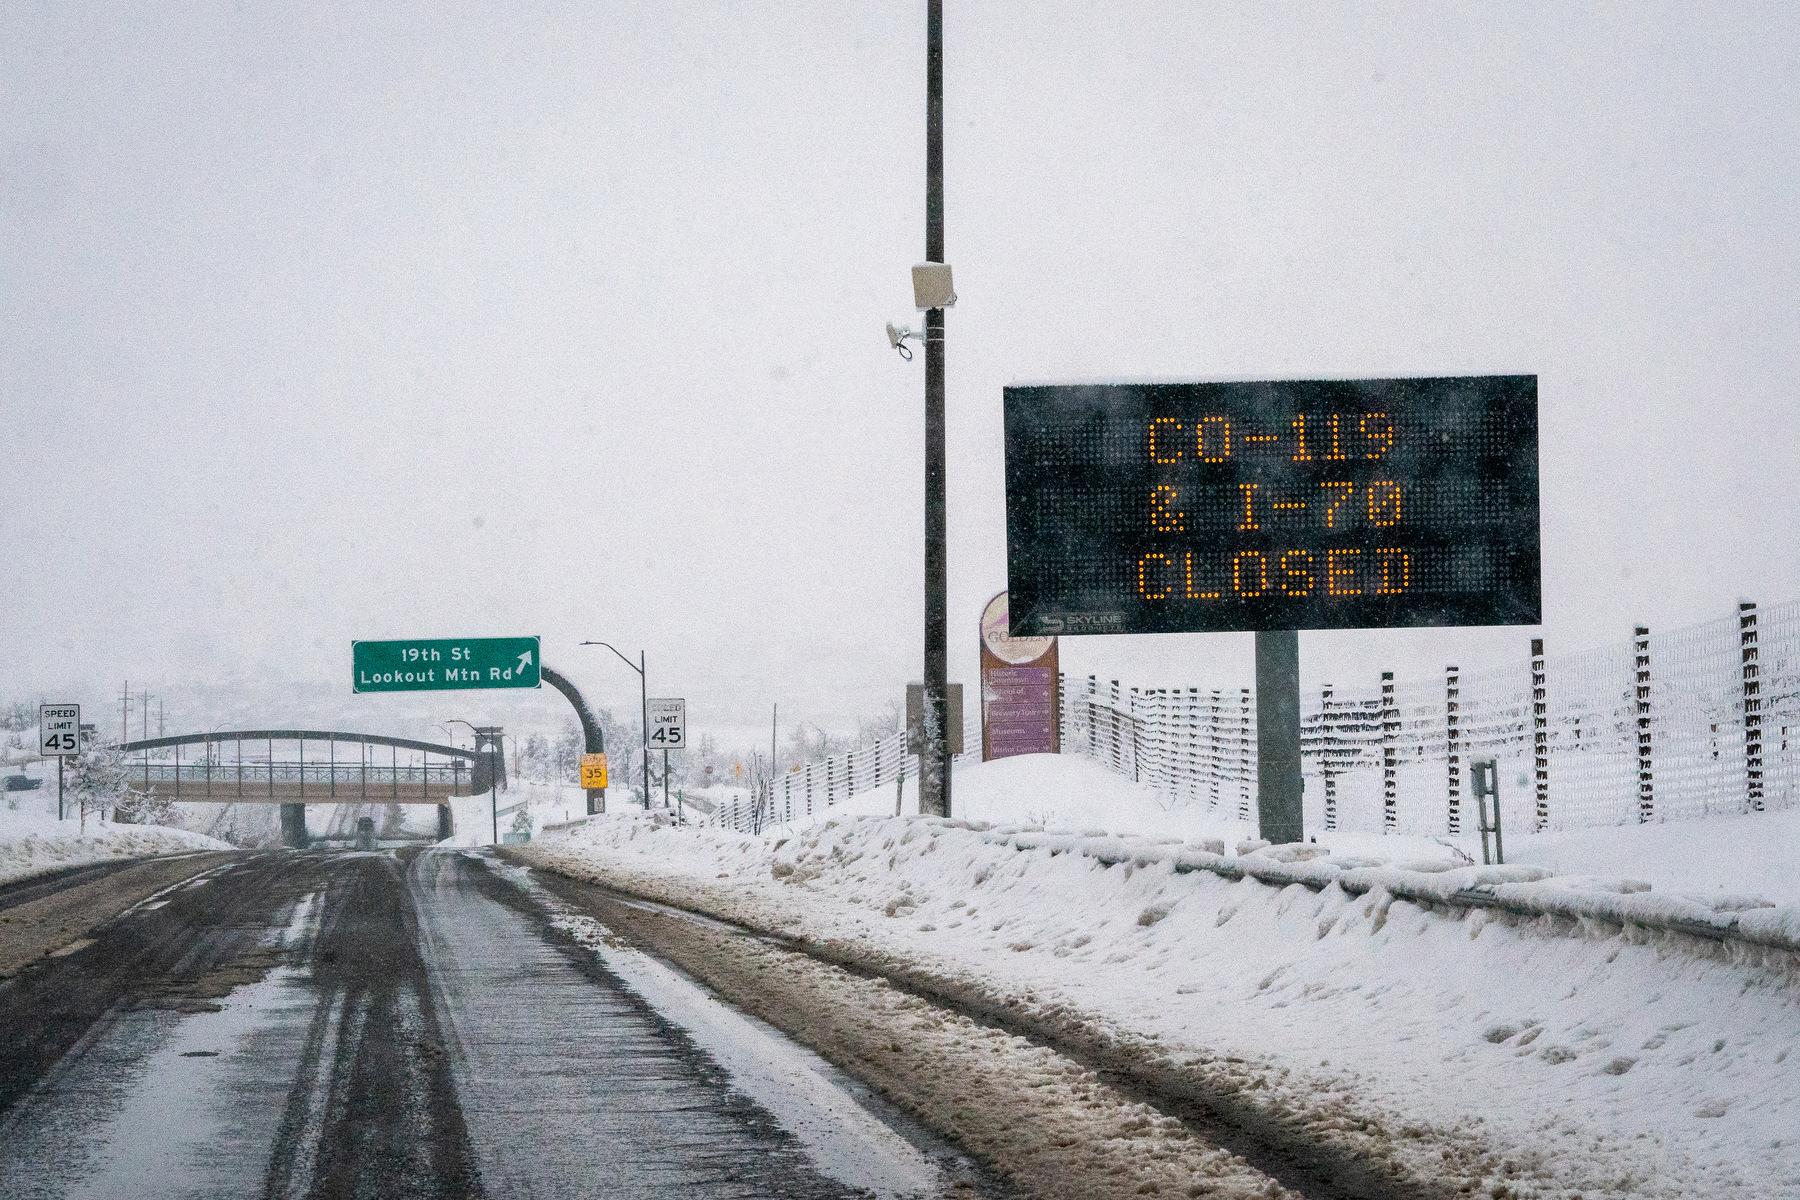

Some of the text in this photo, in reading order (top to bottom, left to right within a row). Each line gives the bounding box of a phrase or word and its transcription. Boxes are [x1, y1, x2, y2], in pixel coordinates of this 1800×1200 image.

[1150, 412, 1393, 464] CO-119
[1151, 480, 1401, 532] & I-70
[1138, 547, 1409, 600] CLOSED
[1066, 615, 1122, 625] SKYLINE
[402, 647, 471, 661] 19th St
[360, 667, 512, 684] Lookout Mtn Rd
[45, 710, 76, 718] SPEED
[655, 715, 678, 723] LIMIT
[48, 722, 72, 730] LIMIT
[45, 733, 76, 750] 45
[652, 727, 682, 743] 45
[586, 768, 602, 779] 35
